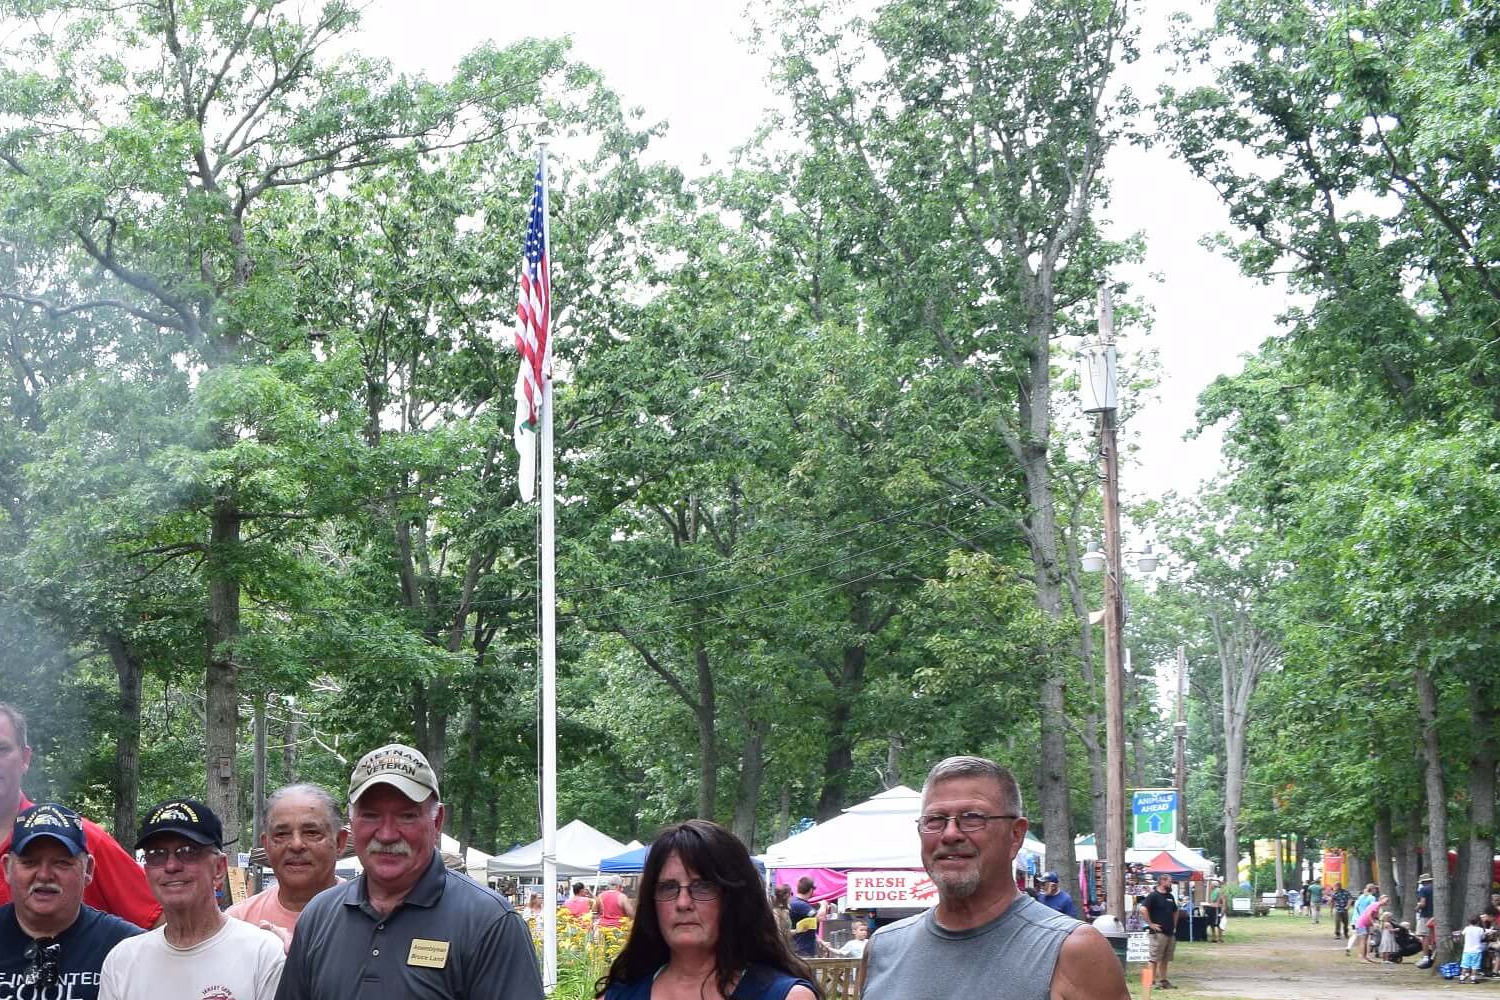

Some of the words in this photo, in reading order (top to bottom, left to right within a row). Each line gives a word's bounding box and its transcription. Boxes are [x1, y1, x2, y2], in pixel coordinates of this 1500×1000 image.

[362, 749, 424, 768] VIETNAM
[366, 762, 416, 776] VETERAN
[1137, 795, 1173, 806] ANIMALS
[1141, 803, 1170, 813] AHEAD
[855, 877, 906, 888] FRESH
[855, 890, 908, 901] FUDGE
[11, 972, 101, 986] INNTED
